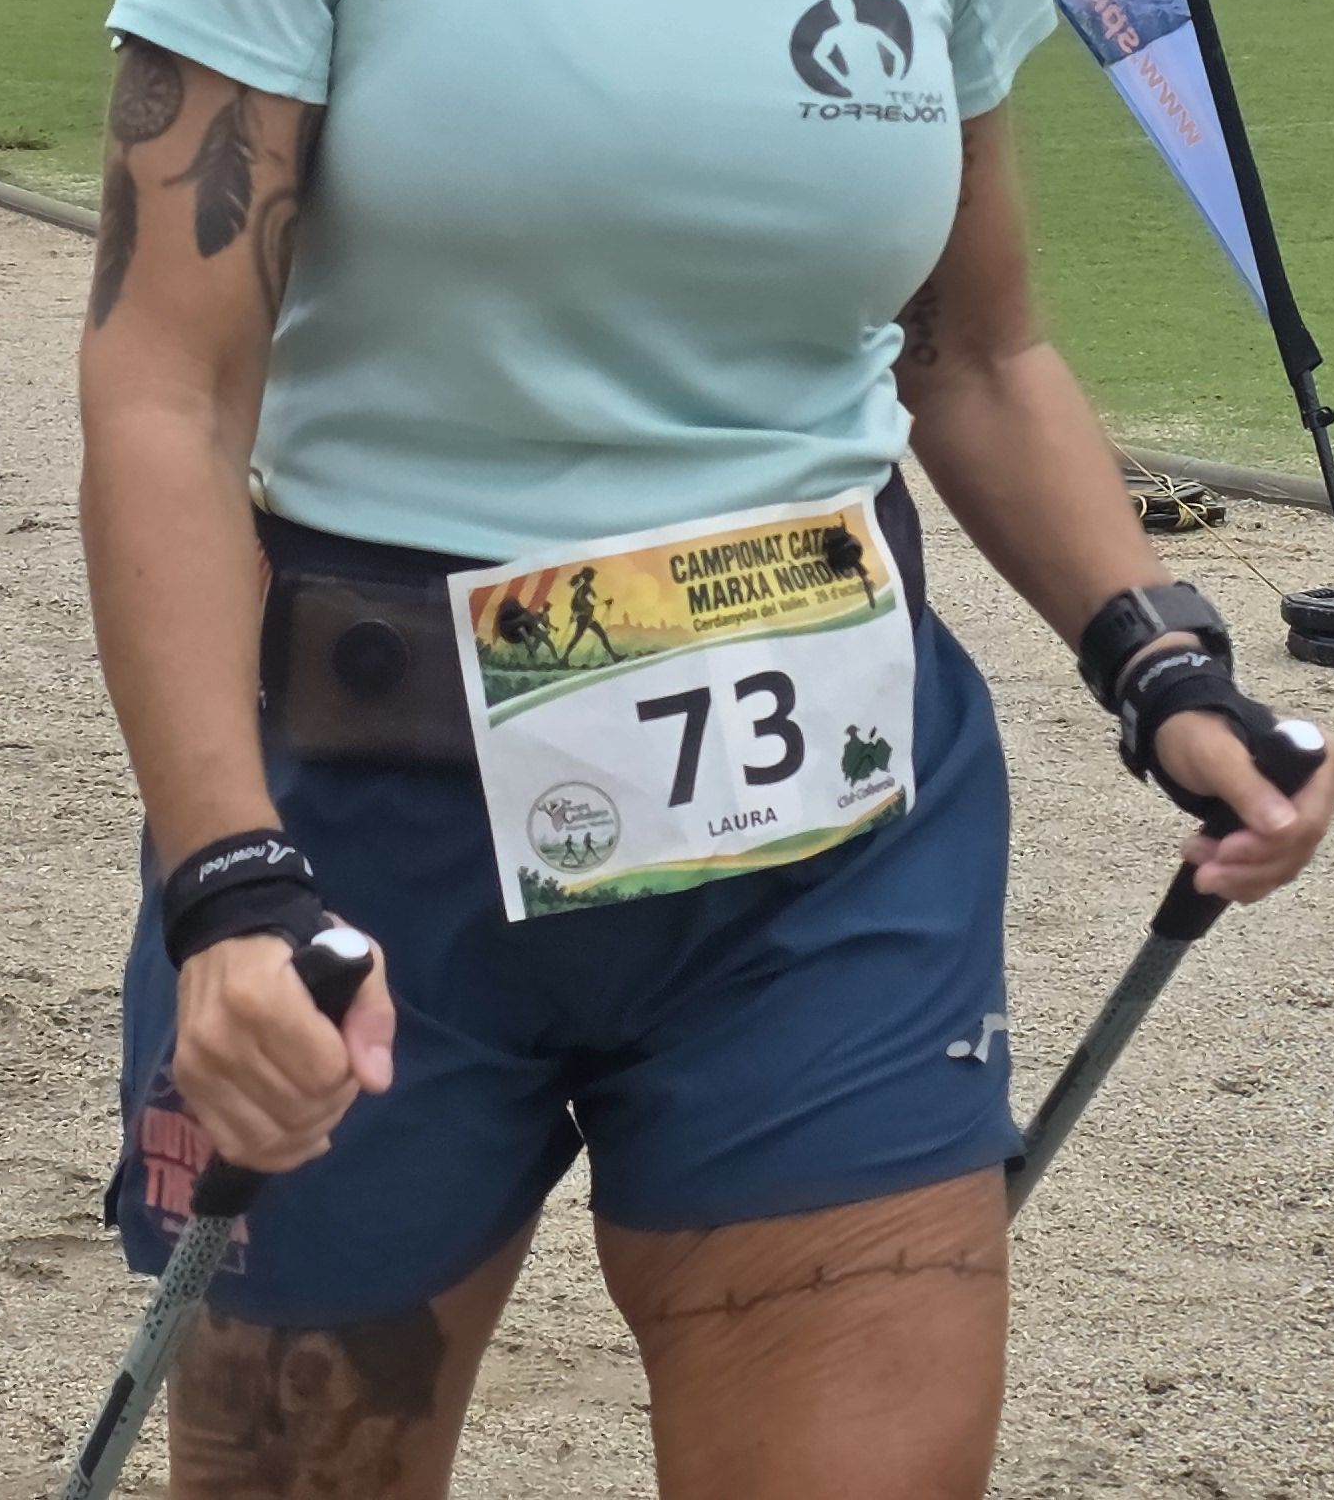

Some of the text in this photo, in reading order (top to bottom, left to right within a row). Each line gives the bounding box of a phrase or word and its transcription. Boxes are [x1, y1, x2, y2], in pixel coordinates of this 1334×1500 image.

[670, 534, 784, 585] CAMPIONAT
[687, 570, 774, 615] MARXA
[636, 670, 806, 808] 73
[708, 806, 778, 838] LAURA
